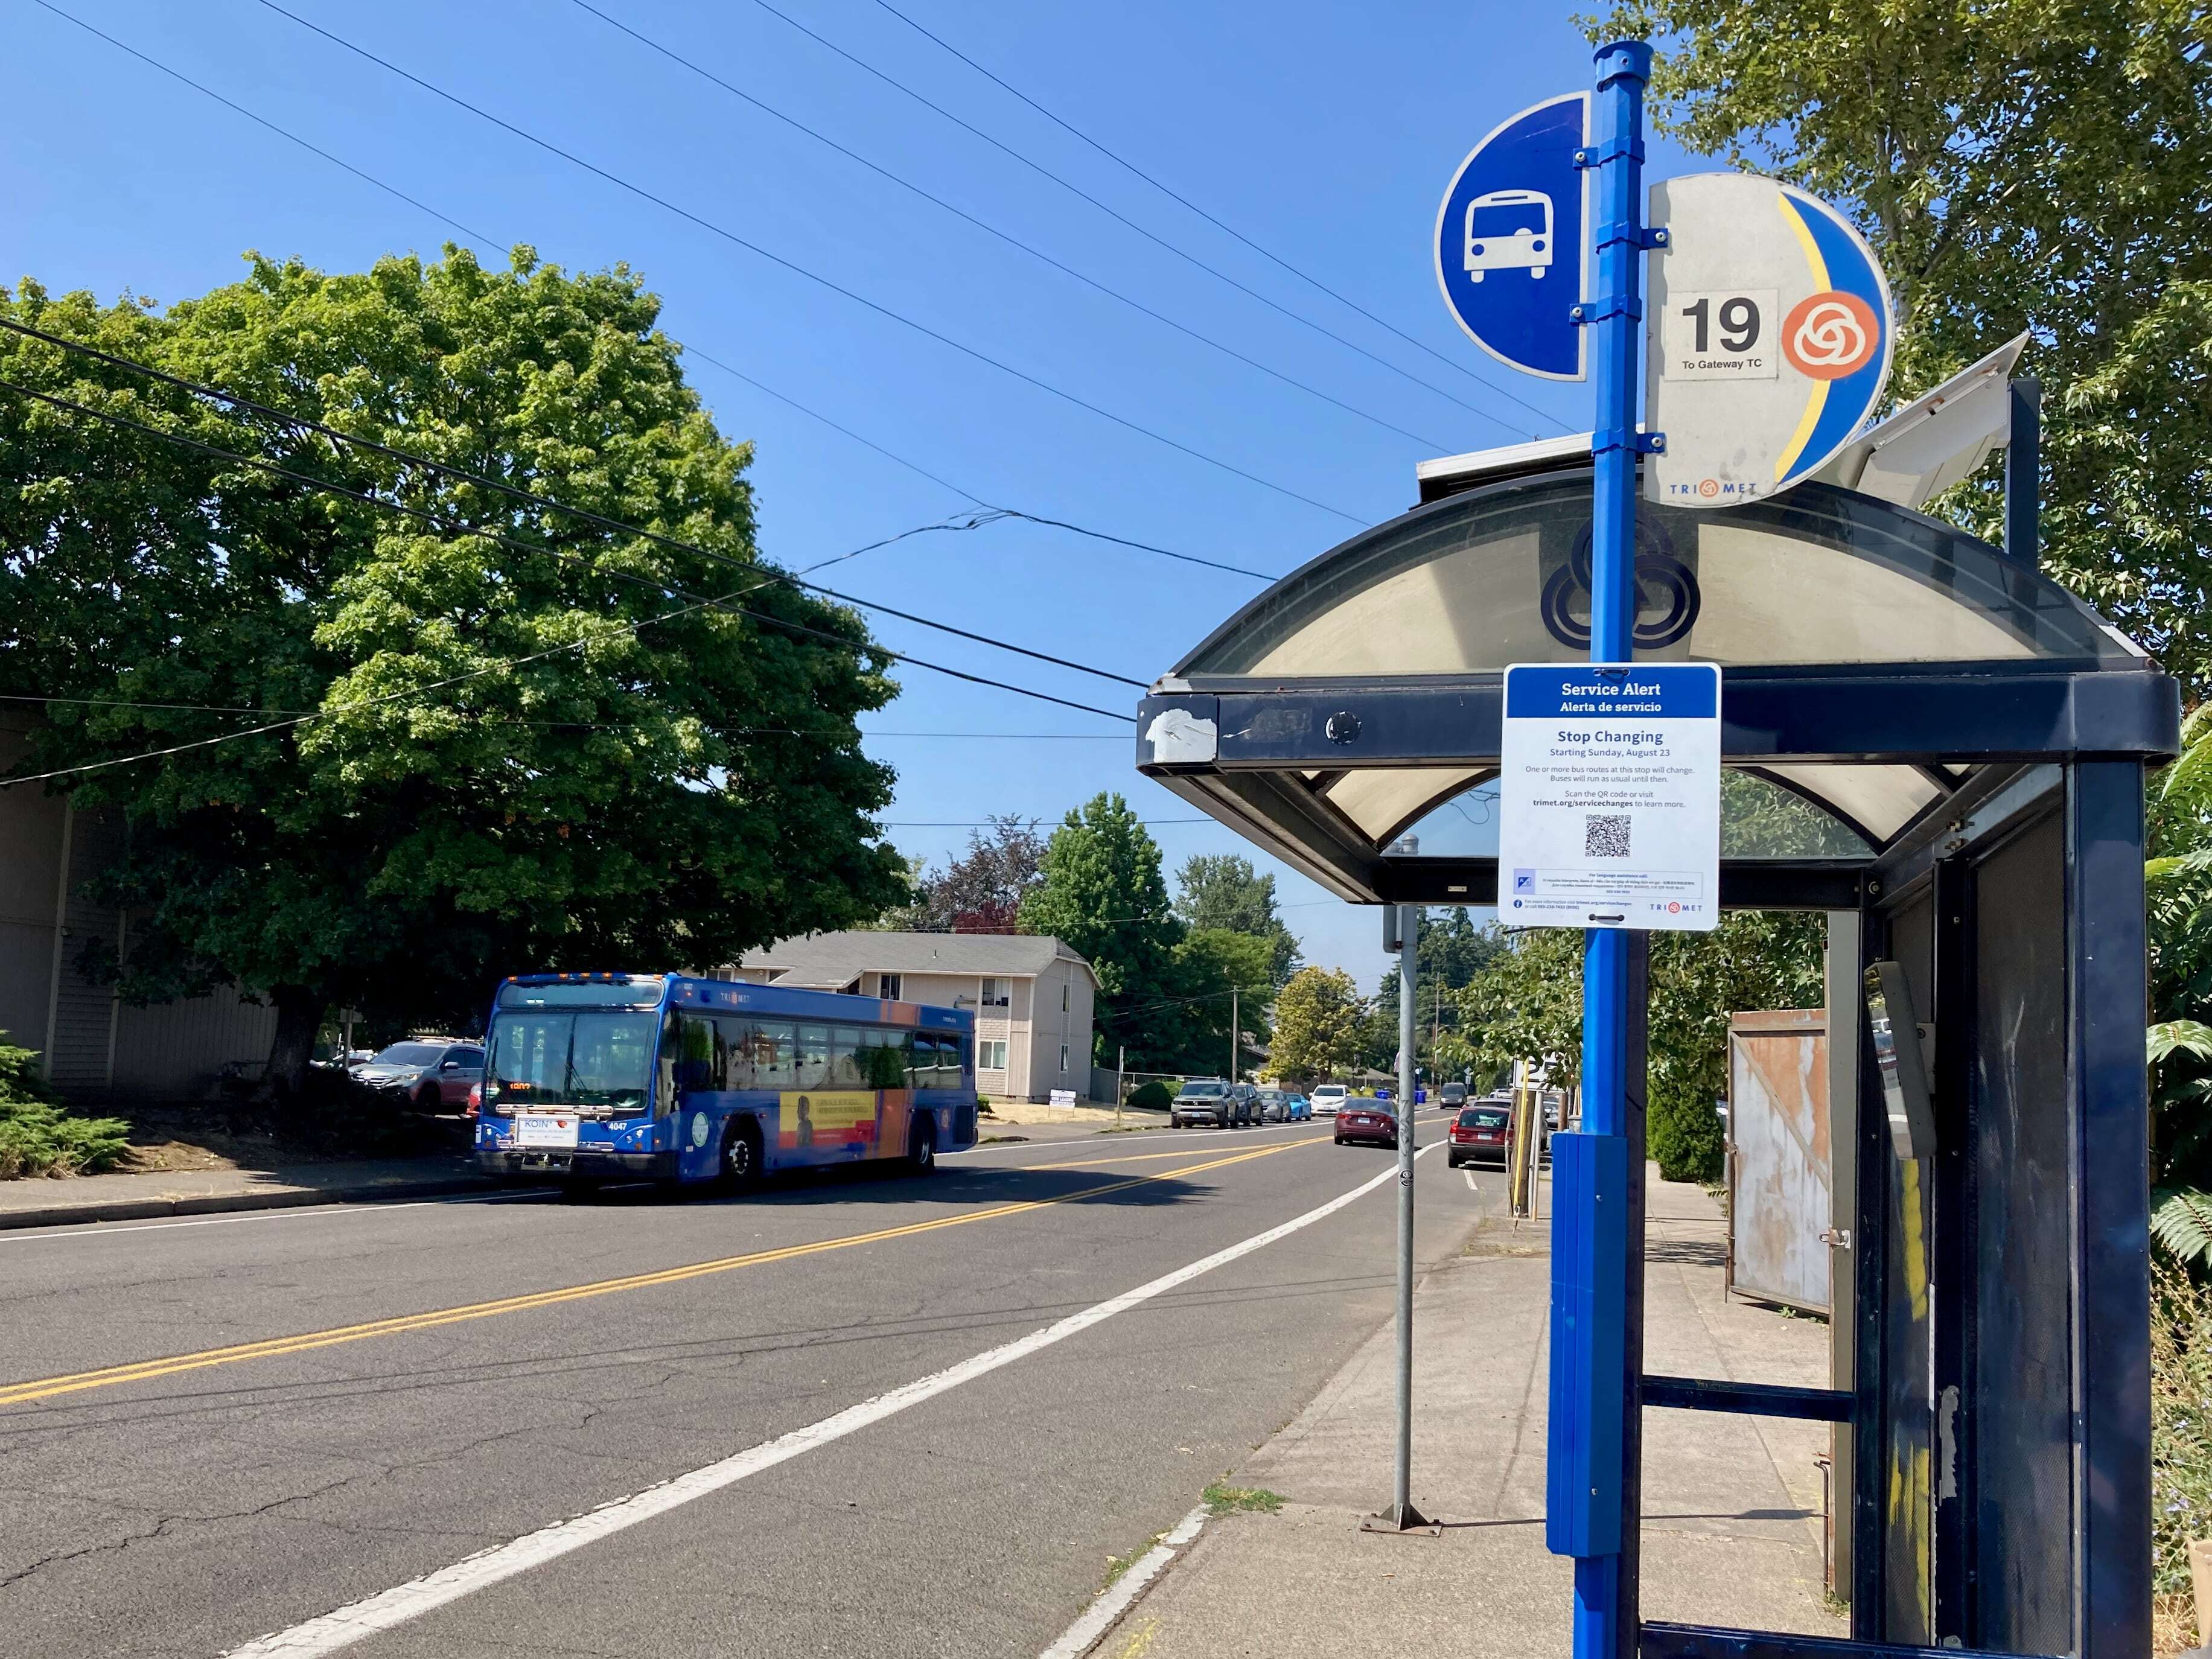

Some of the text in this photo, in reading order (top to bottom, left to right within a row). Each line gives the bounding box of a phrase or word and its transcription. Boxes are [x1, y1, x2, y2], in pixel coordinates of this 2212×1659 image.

[1682, 298, 1761, 352] 19
[1682, 359, 1762, 370] To Gateway TC
[1562, 683, 1661, 695] Service Alert
[1560, 702, 1662, 712] Alerta de servicio
[1558, 730, 1663, 745] Stop Changing
[1550, 748, 1586, 758] Starting
[1588, 748, 1624, 758] Sunday,
[1626, 749, 1657, 758] August
[1666, 766, 1695, 775] change.
[1533, 799, 1633, 808] trimet.org/servicechanges
